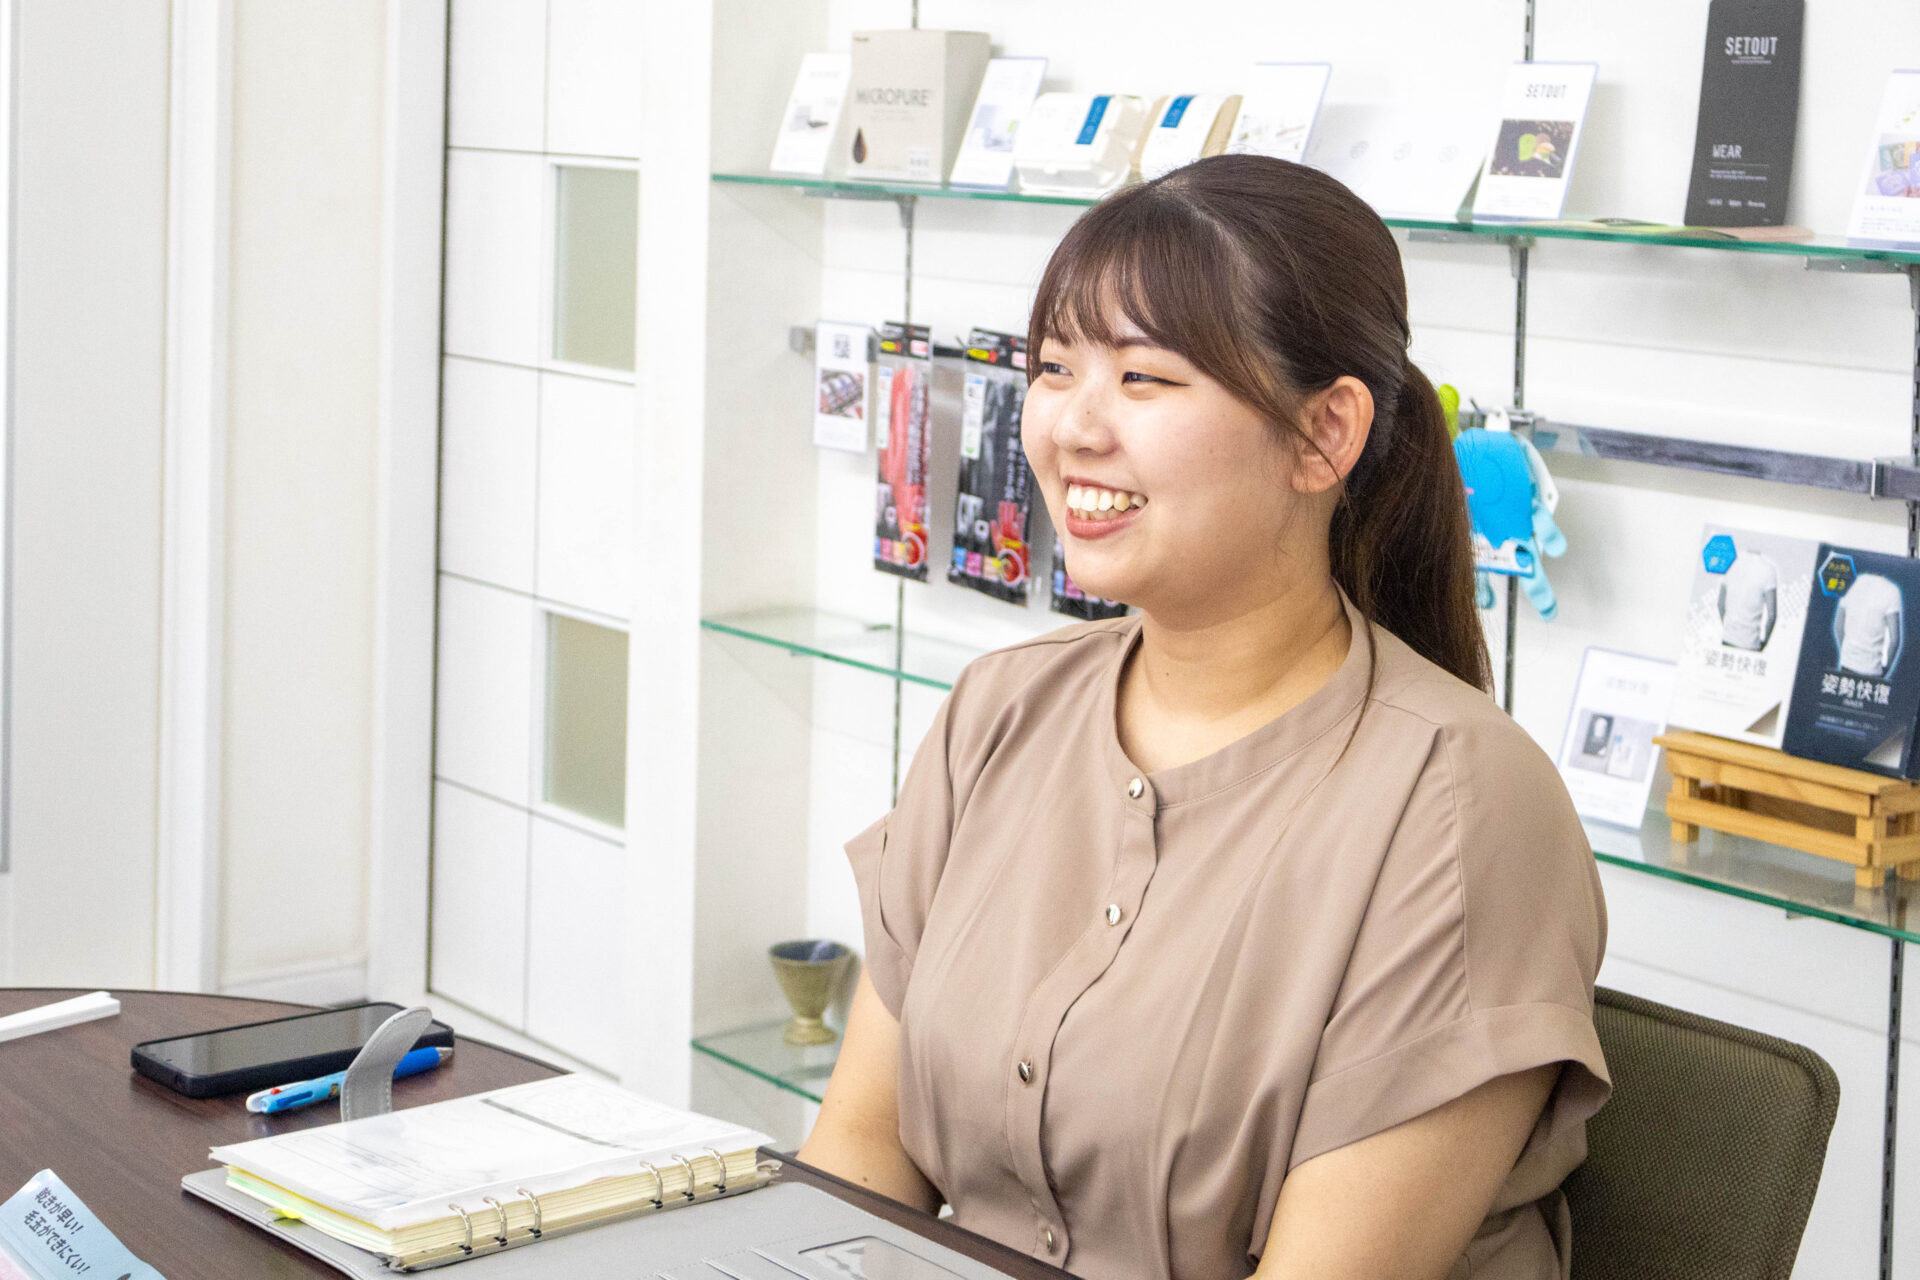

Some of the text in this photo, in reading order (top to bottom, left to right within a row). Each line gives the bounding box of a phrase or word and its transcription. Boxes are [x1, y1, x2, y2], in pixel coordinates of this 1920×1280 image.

[1724, 36, 1778, 56] SETOUT
[1525, 83, 1567, 99] SETOUT
[1712, 144, 1742, 159] WEAR
